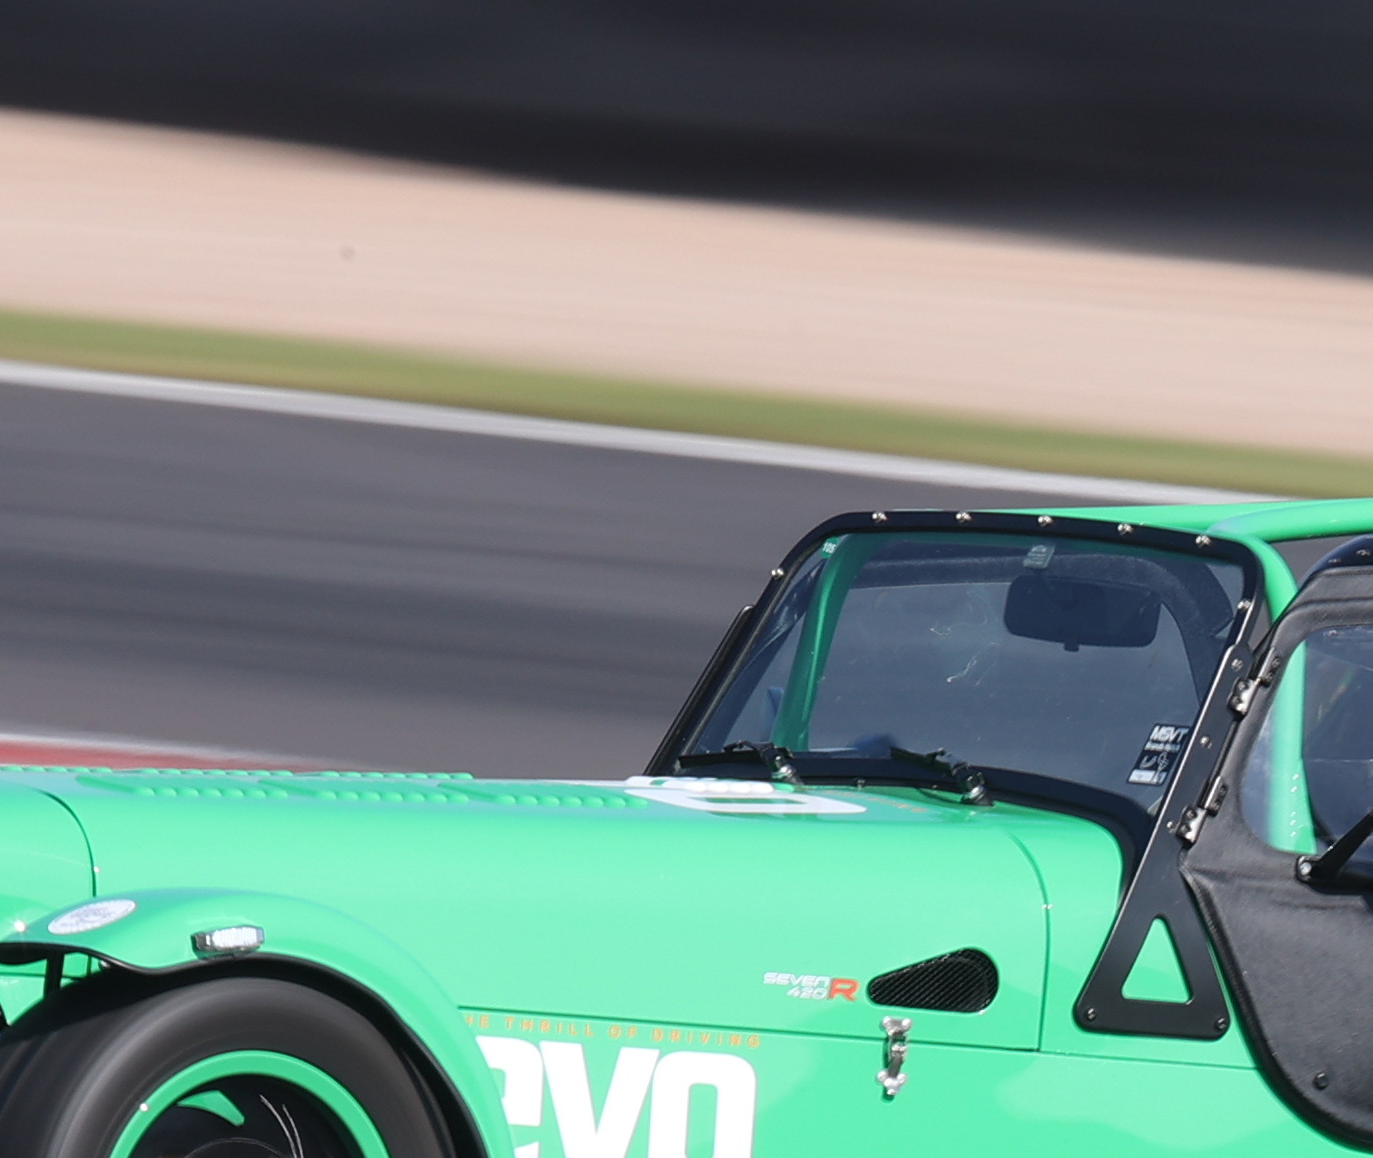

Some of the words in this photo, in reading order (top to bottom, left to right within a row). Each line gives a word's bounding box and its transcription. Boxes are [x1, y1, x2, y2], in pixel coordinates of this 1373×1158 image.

[504, 1016, 594, 1037] THRILL
[607, 1025, 638, 1040] OF
[650, 1028, 760, 1048] DRIVING
